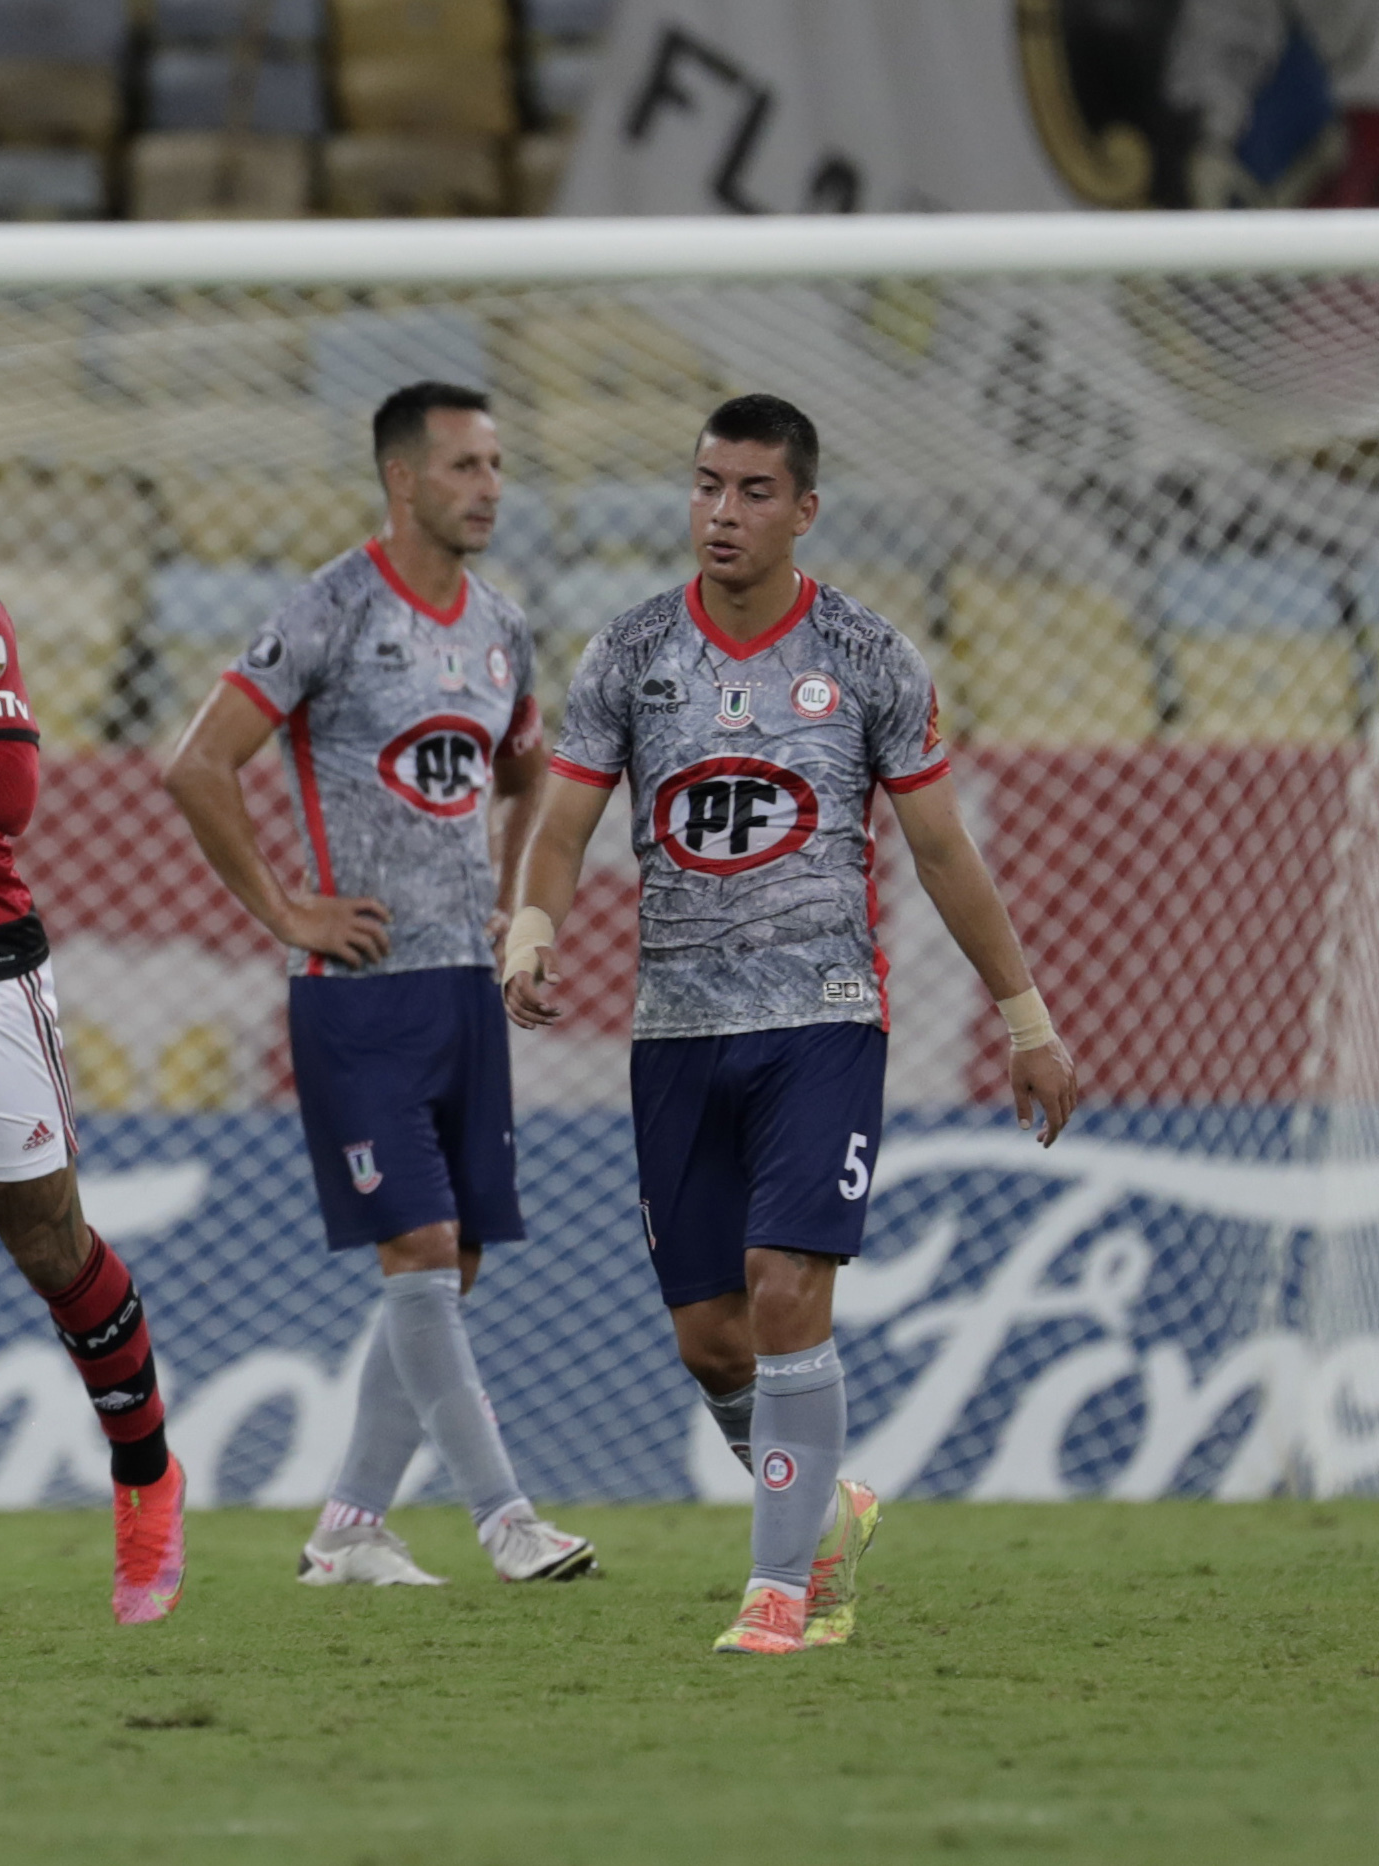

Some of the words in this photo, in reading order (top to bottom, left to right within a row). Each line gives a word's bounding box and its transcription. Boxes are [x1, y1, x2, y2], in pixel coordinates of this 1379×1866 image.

[802, 687, 826, 703] ULC
[685, 780, 777, 855] PF
[838, 1132, 869, 1201] 5
